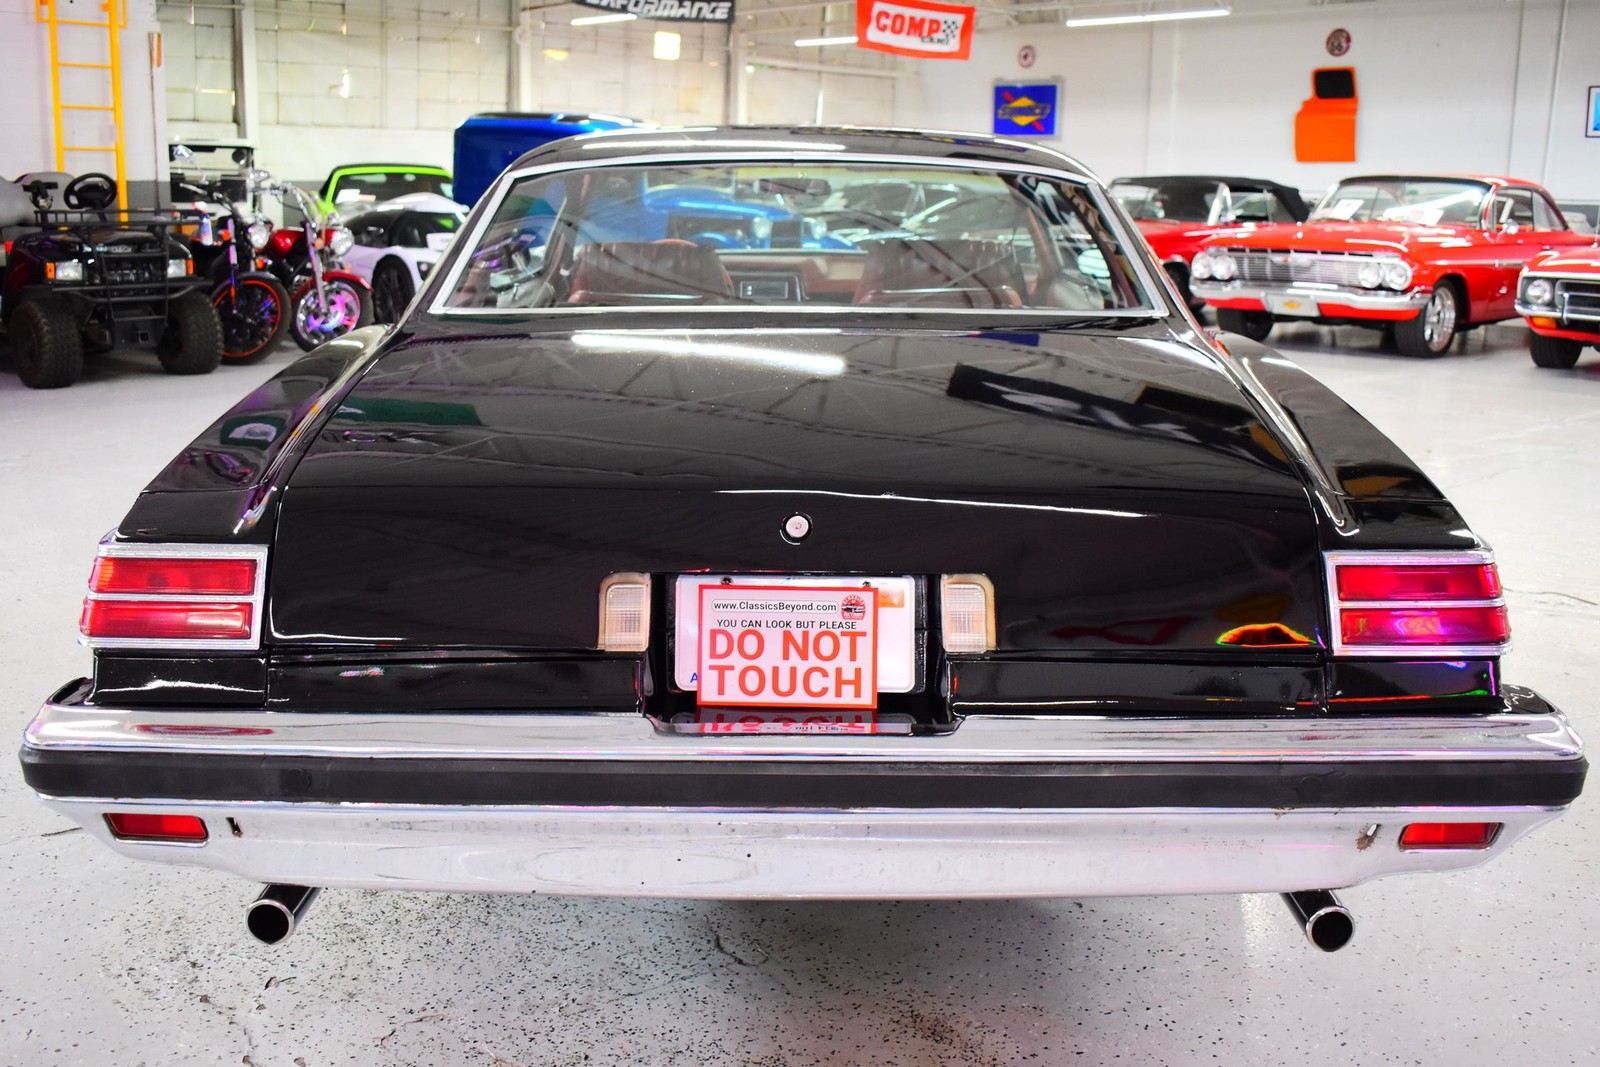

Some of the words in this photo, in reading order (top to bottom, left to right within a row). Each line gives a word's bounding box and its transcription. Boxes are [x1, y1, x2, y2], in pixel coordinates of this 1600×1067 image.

[876, 11, 942, 38] COMP
[713, 601, 837, 612] www.ClassicsBeyond.com
[717, 619, 737, 628] YOU
[741, 619, 762, 628] CAN
[766, 620, 792, 629] LOOK
[796, 620, 816, 629] BUT
[819, 621, 857, 630] PLEASE
[709, 629, 765, 660] DO
[782, 630, 867, 662] NOT
[708, 665, 862, 698] TOUCH
